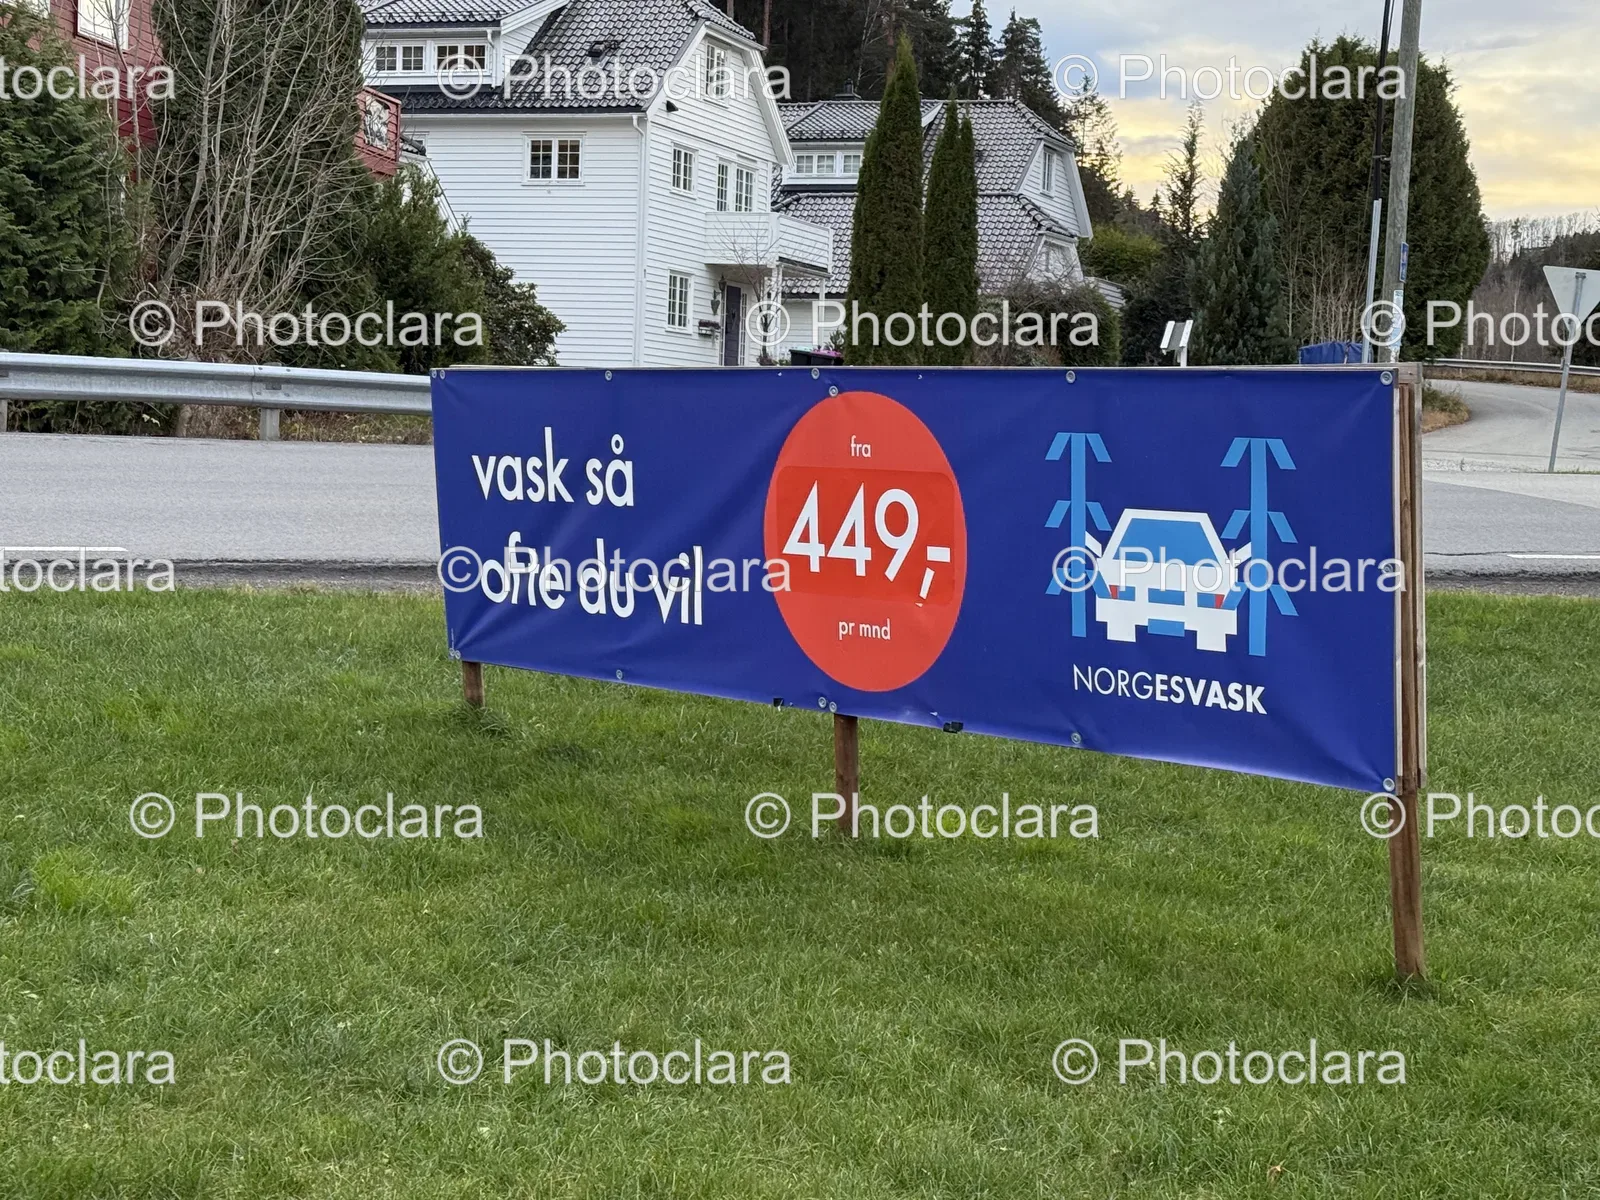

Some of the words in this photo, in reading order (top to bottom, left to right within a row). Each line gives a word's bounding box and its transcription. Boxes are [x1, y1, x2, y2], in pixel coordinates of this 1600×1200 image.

[471, 426, 574, 502] vask
[585, 433, 634, 506] så
[850, 434, 871, 458] fra
[480, 531, 565, 610] ofte
[579, 538, 635, 618] du
[648, 545, 702, 625] vil
[838, 621, 855, 641] pr
[859, 618, 891, 640] mnd
[1073, 664, 1267, 715] NORGESVASK
